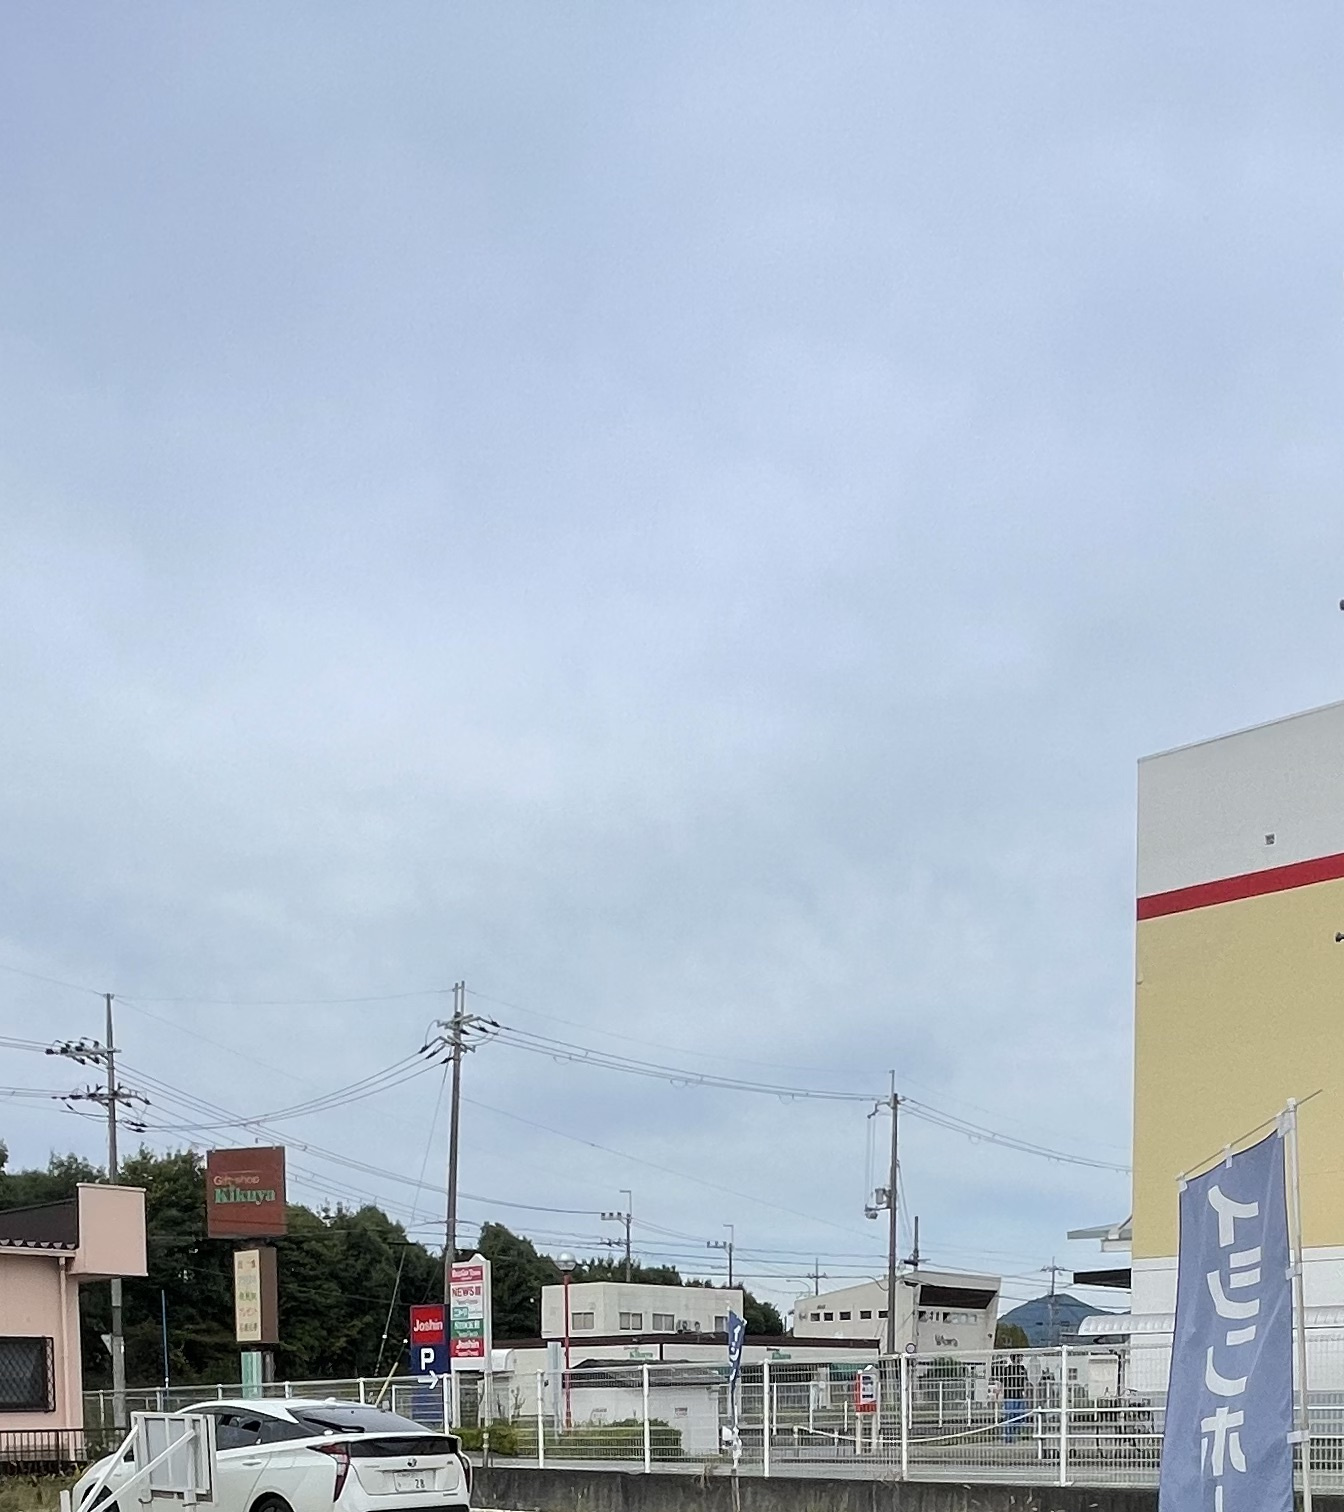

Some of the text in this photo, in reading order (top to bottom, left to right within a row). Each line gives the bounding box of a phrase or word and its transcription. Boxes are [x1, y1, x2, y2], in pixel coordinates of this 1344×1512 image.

[215, 1187, 276, 1205] Kikuya
[413, 1319, 444, 1332] Joshin
[420, 1347, 436, 1371] P
